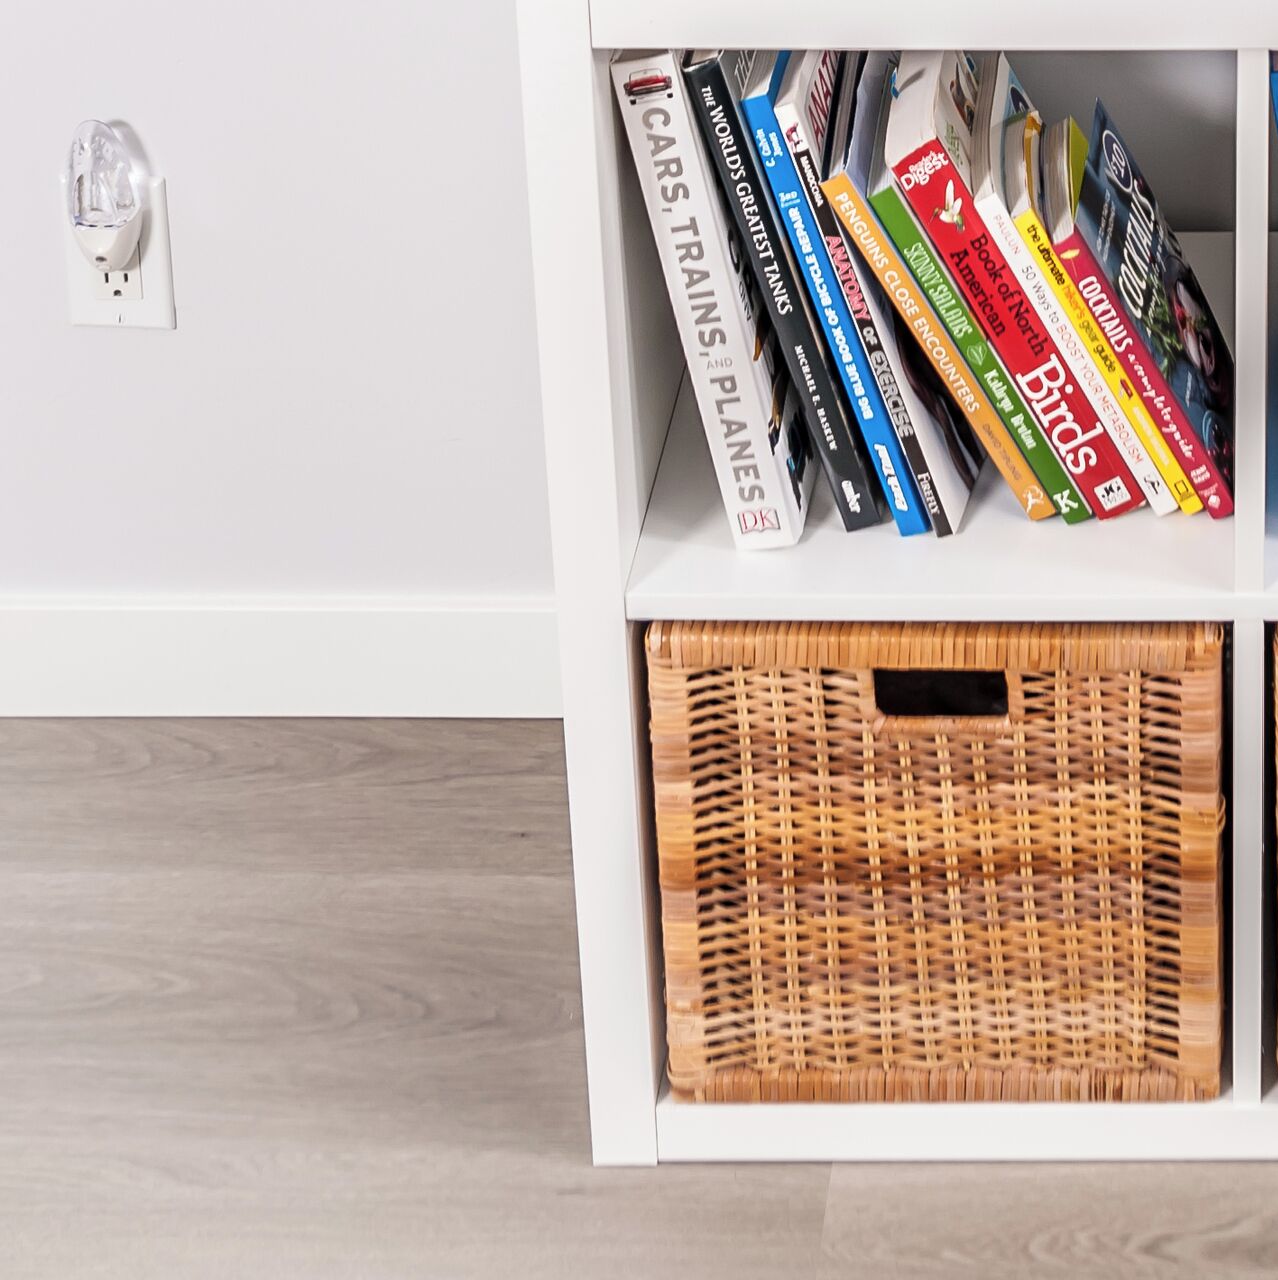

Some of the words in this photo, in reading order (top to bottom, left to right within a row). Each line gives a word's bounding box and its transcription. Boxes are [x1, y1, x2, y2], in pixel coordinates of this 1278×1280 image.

[641, 106, 690, 213] CARS,
[799, 155, 824, 207] MANOCCHIA
[900, 152, 949, 191] Digest
[701, 85, 716, 108] THE
[709, 104, 746, 181] WORLD'S
[735, 182, 774, 261] GREATEST
[764, 260, 793, 315] TANKS
[788, 206, 813, 252] REPAIR
[1118, 178, 1155, 319] COCKTAILS
[805, 252, 833, 307] BICYCLE
[970, 232, 1003, 284] Book
[670, 216, 727, 357] TRAINS,
[836, 192, 889, 269] PENGUINS
[884, 270, 919, 317] CLOSE
[913, 317, 980, 414] ENCOUNTERS
[903, 242, 943, 289] SKINNY
[929, 283, 973, 338] SALADS
[950, 248, 1007, 337] American
[998, 282, 1021, 304] of
[1027, 224, 1041, 243] the
[1037, 243, 1065, 285] ultimate
[1063, 284, 1086, 321] hiker's
[1078, 320, 1100, 343] gear
[1093, 343, 1116, 373] guide
[1078, 275, 1134, 353] COCKTAILS
[824, 307, 839, 325] OF
[825, 235, 870, 320] ANATOMY
[862, 326, 878, 346] OF
[870, 350, 914, 438] EXERCISE
[831, 325, 853, 361] BOOK
[1008, 299, 1046, 357] North
[706, 357, 733, 371] AND
[794, 344, 816, 394] MICHAEL
[845, 361, 866, 397] BLUE
[1021, 265, 1037, 281] 50
[1032, 281, 1051, 310] Ways
[1049, 310, 1059, 324] to
[1056, 322, 1085, 363] BOOST
[1080, 362, 1103, 395] YOUR
[1099, 395, 1143, 465] METABOLISM
[812, 394, 821, 407] E.
[857, 397, 874, 420] BIG
[1015, 353, 1104, 475] Birds
[709, 374, 765, 504] PLANES
[816, 407, 838, 451] HASKEW
[740, 509, 777, 530] DK
